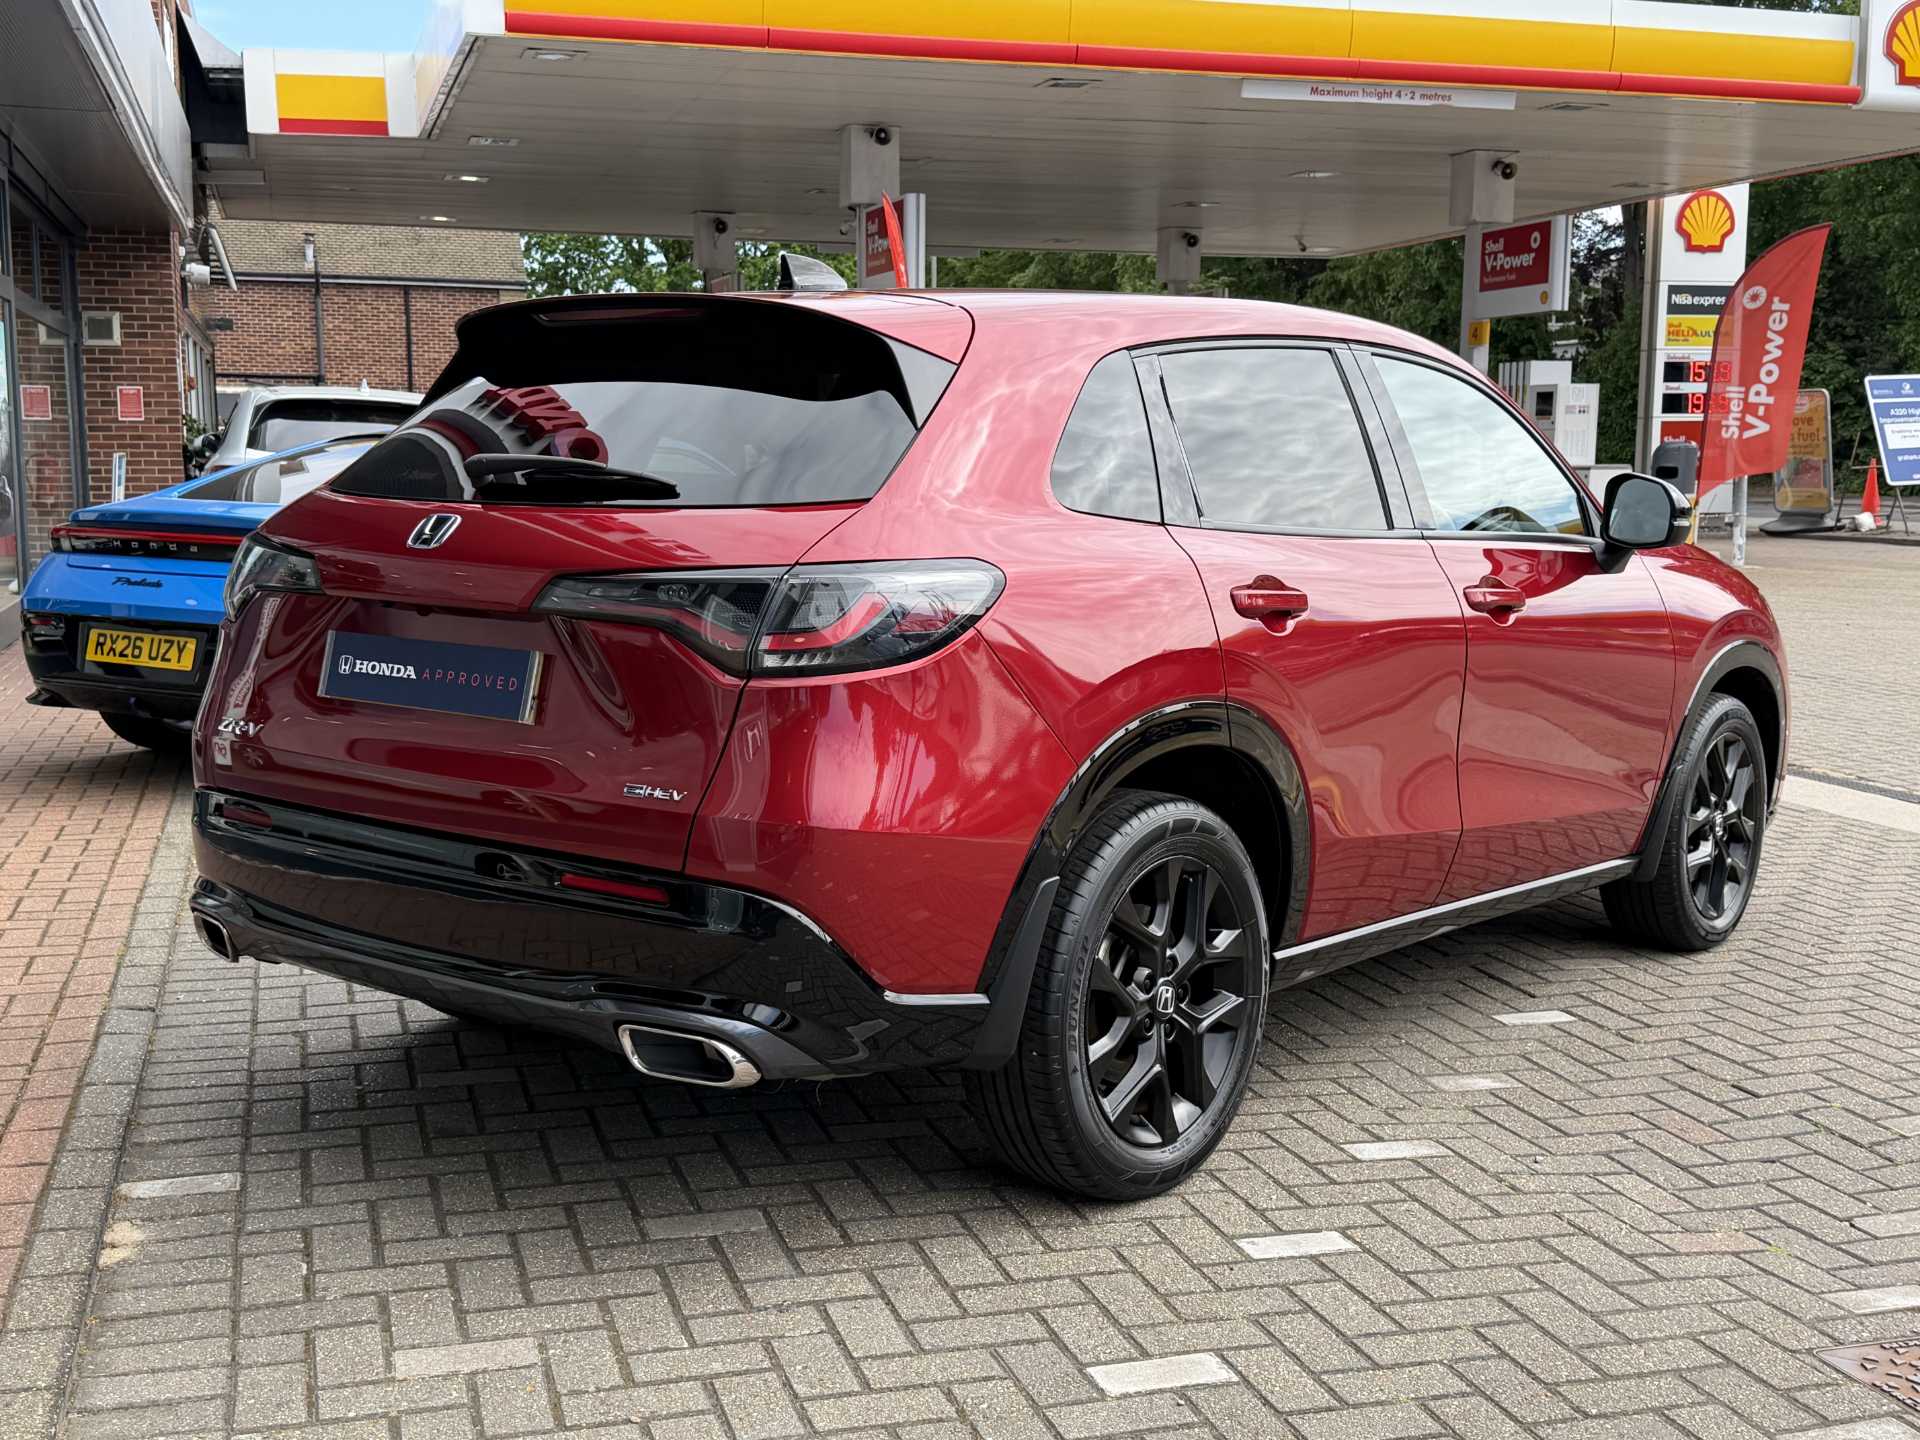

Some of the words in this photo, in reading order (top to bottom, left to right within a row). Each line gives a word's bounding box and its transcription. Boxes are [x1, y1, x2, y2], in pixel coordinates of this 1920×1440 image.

[1309, 86, 1359, 98] Maximum
[1362, 88, 1393, 101] height
[1419, 91, 1452, 102] metres
[1485, 239, 1503, 253] Shell
[1485, 253, 1535, 271] V-Power
[1671, 294, 1692, 305] Nisa
[1743, 296, 1791, 440] V-Power
[1722, 386, 1746, 440] Shell
[148, 636, 189, 665] UZY
[353, 658, 418, 680] HONDA
[422, 667, 520, 692] APPROVED
